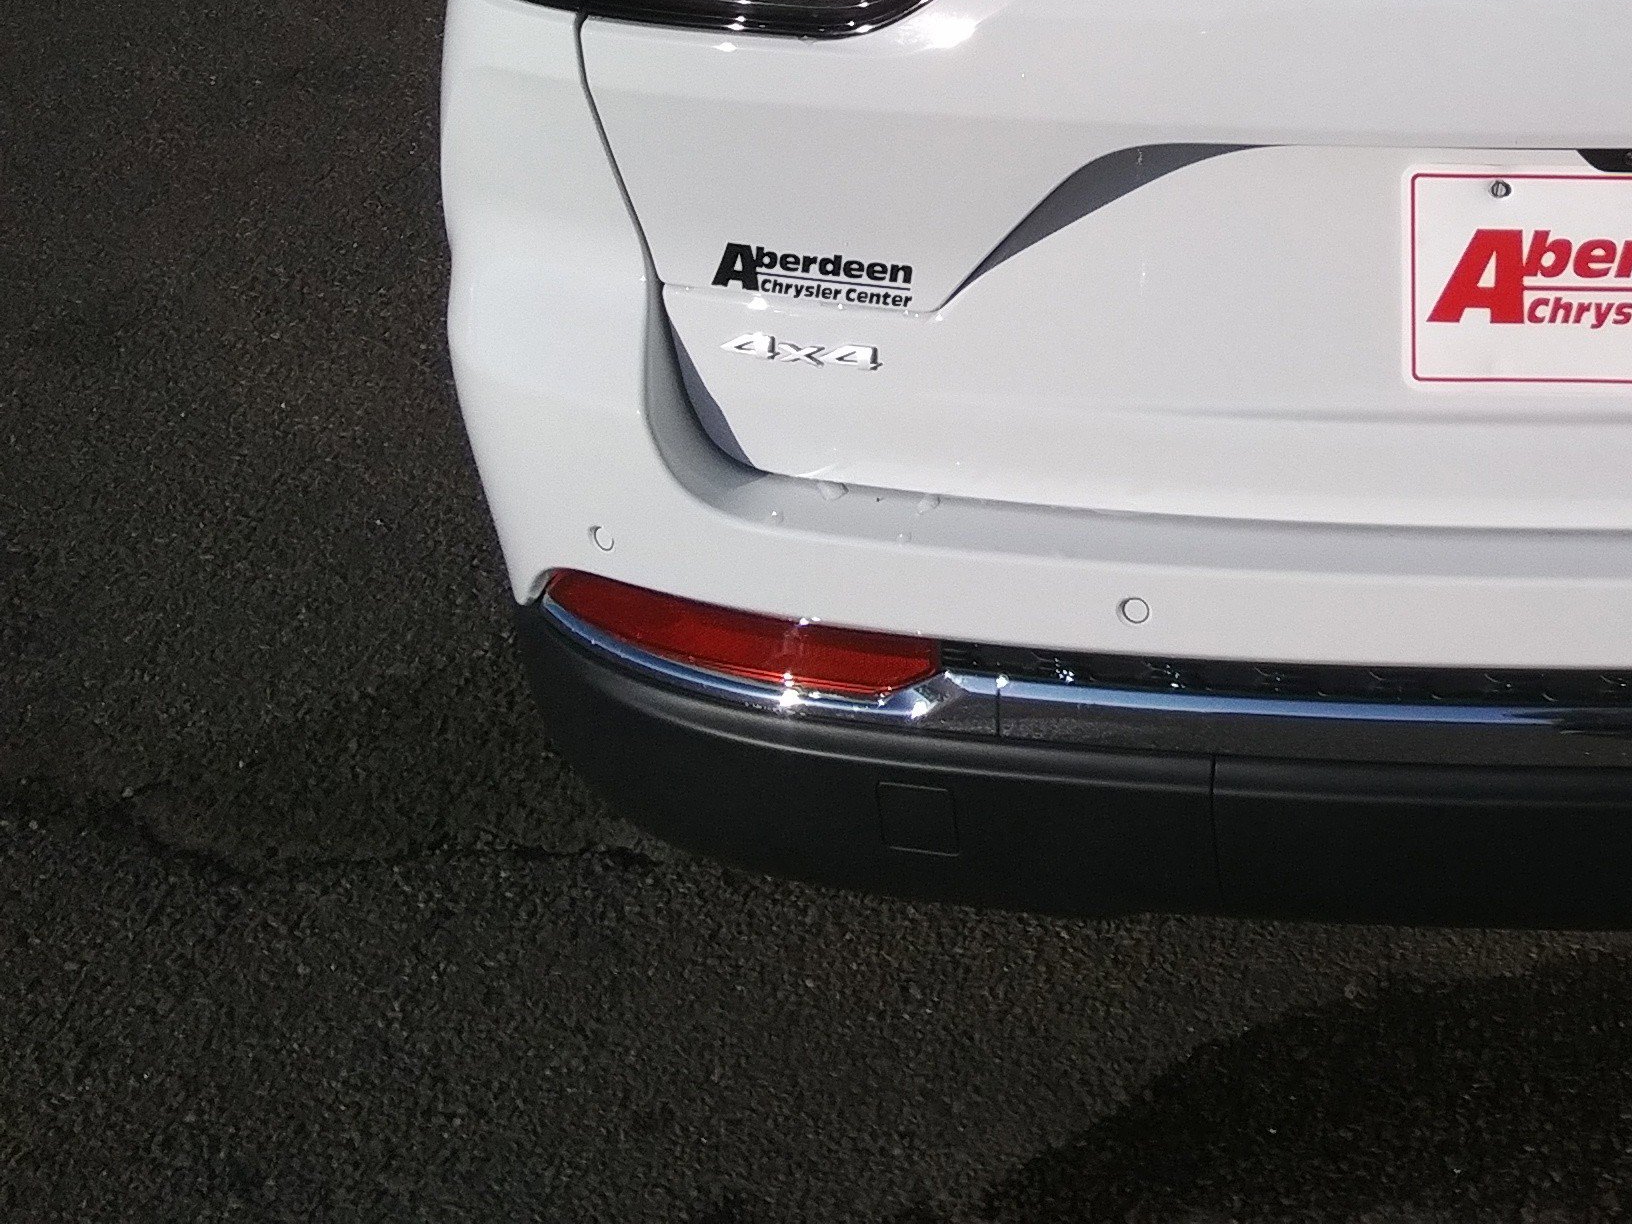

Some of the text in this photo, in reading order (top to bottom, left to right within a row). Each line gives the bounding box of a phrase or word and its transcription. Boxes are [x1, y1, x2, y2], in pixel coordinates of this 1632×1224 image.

[711, 242, 913, 292] Aberdeen
[760, 278, 912, 308] Chrysler Center
